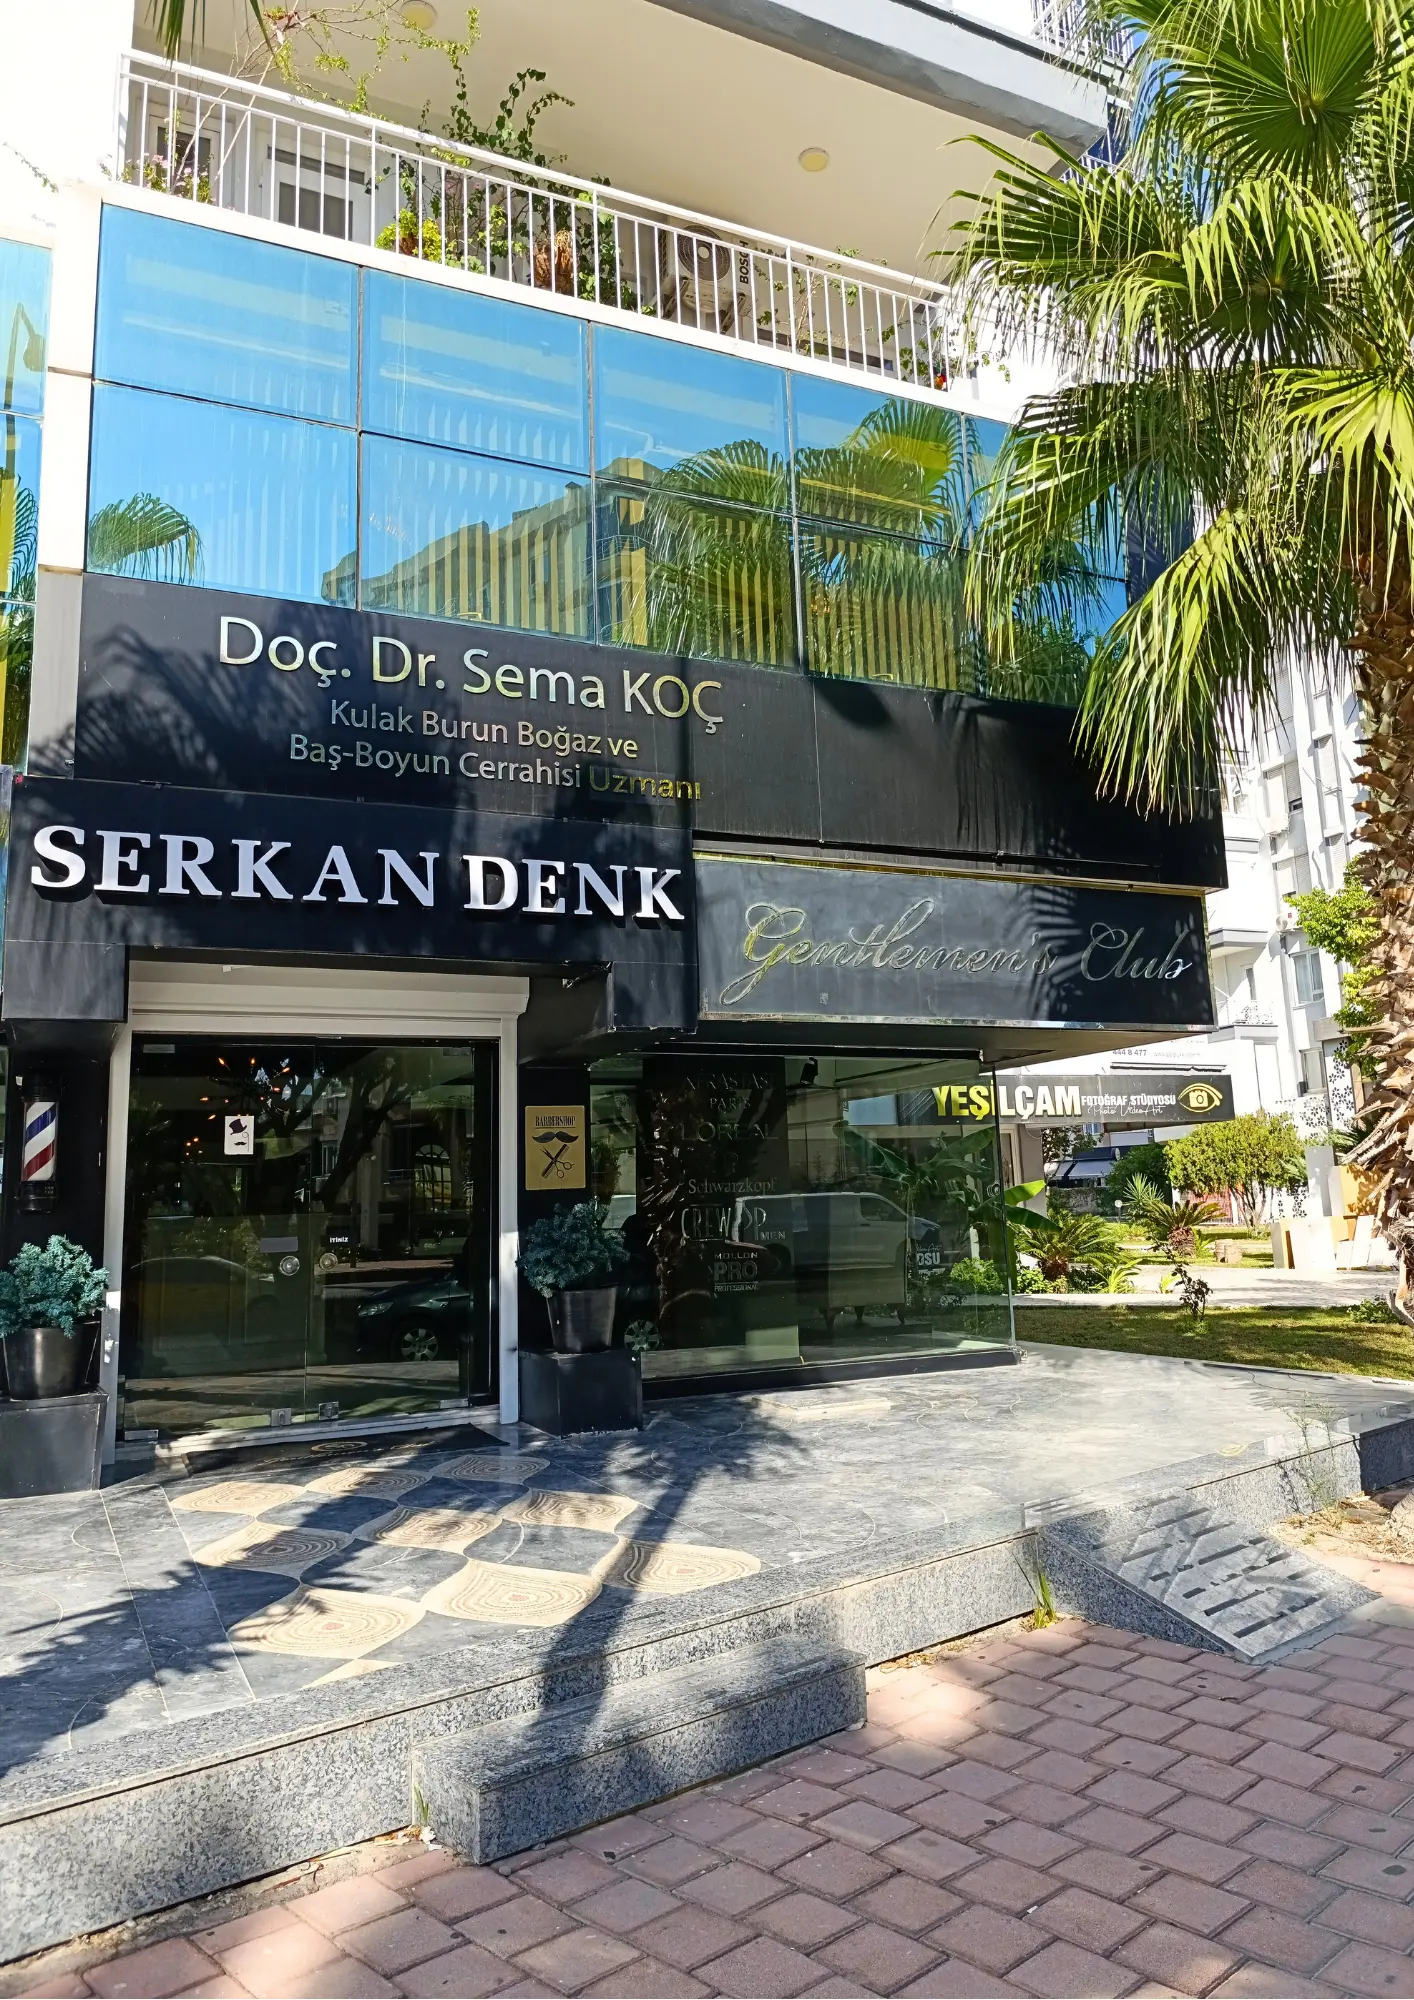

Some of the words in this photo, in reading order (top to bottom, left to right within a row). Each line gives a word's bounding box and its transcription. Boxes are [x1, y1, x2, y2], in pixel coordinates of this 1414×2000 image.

[739, 240, 749, 284] BOSCH
[219, 615, 351, 688] Doç.
[372, 636, 446, 690] Dr.
[463, 648, 606, 710] Sema
[622, 669, 725, 734] KOÇ
[331, 699, 414, 734] Kulak
[421, 709, 508, 745] Burun
[518, 720, 602, 758] Boğaz
[608, 738, 639, 760] ve
[290, 733, 450, 778] Baş-Boyun
[459, 751, 581, 789] Cerrahisi
[589, 765, 701, 800] Uzmanı
[30, 825, 437, 908] SERKAN
[462, 853, 685, 921] DENK
[719, 897, 1057, 1006] Gentlemen's
[1080, 922, 1193, 981] Club
[535, 1115, 576, 1127] BARBERSHOP
[931, 1079, 1082, 1121] YEŞİLÇAM
[1081, 1092, 1128, 1106] FOTOĞRAF
[1130, 1092, 1176, 1106] STÜDYOSU
[688, 1177, 778, 1197] Schwarzkopf
[713, 1261, 758, 1281] PRO
